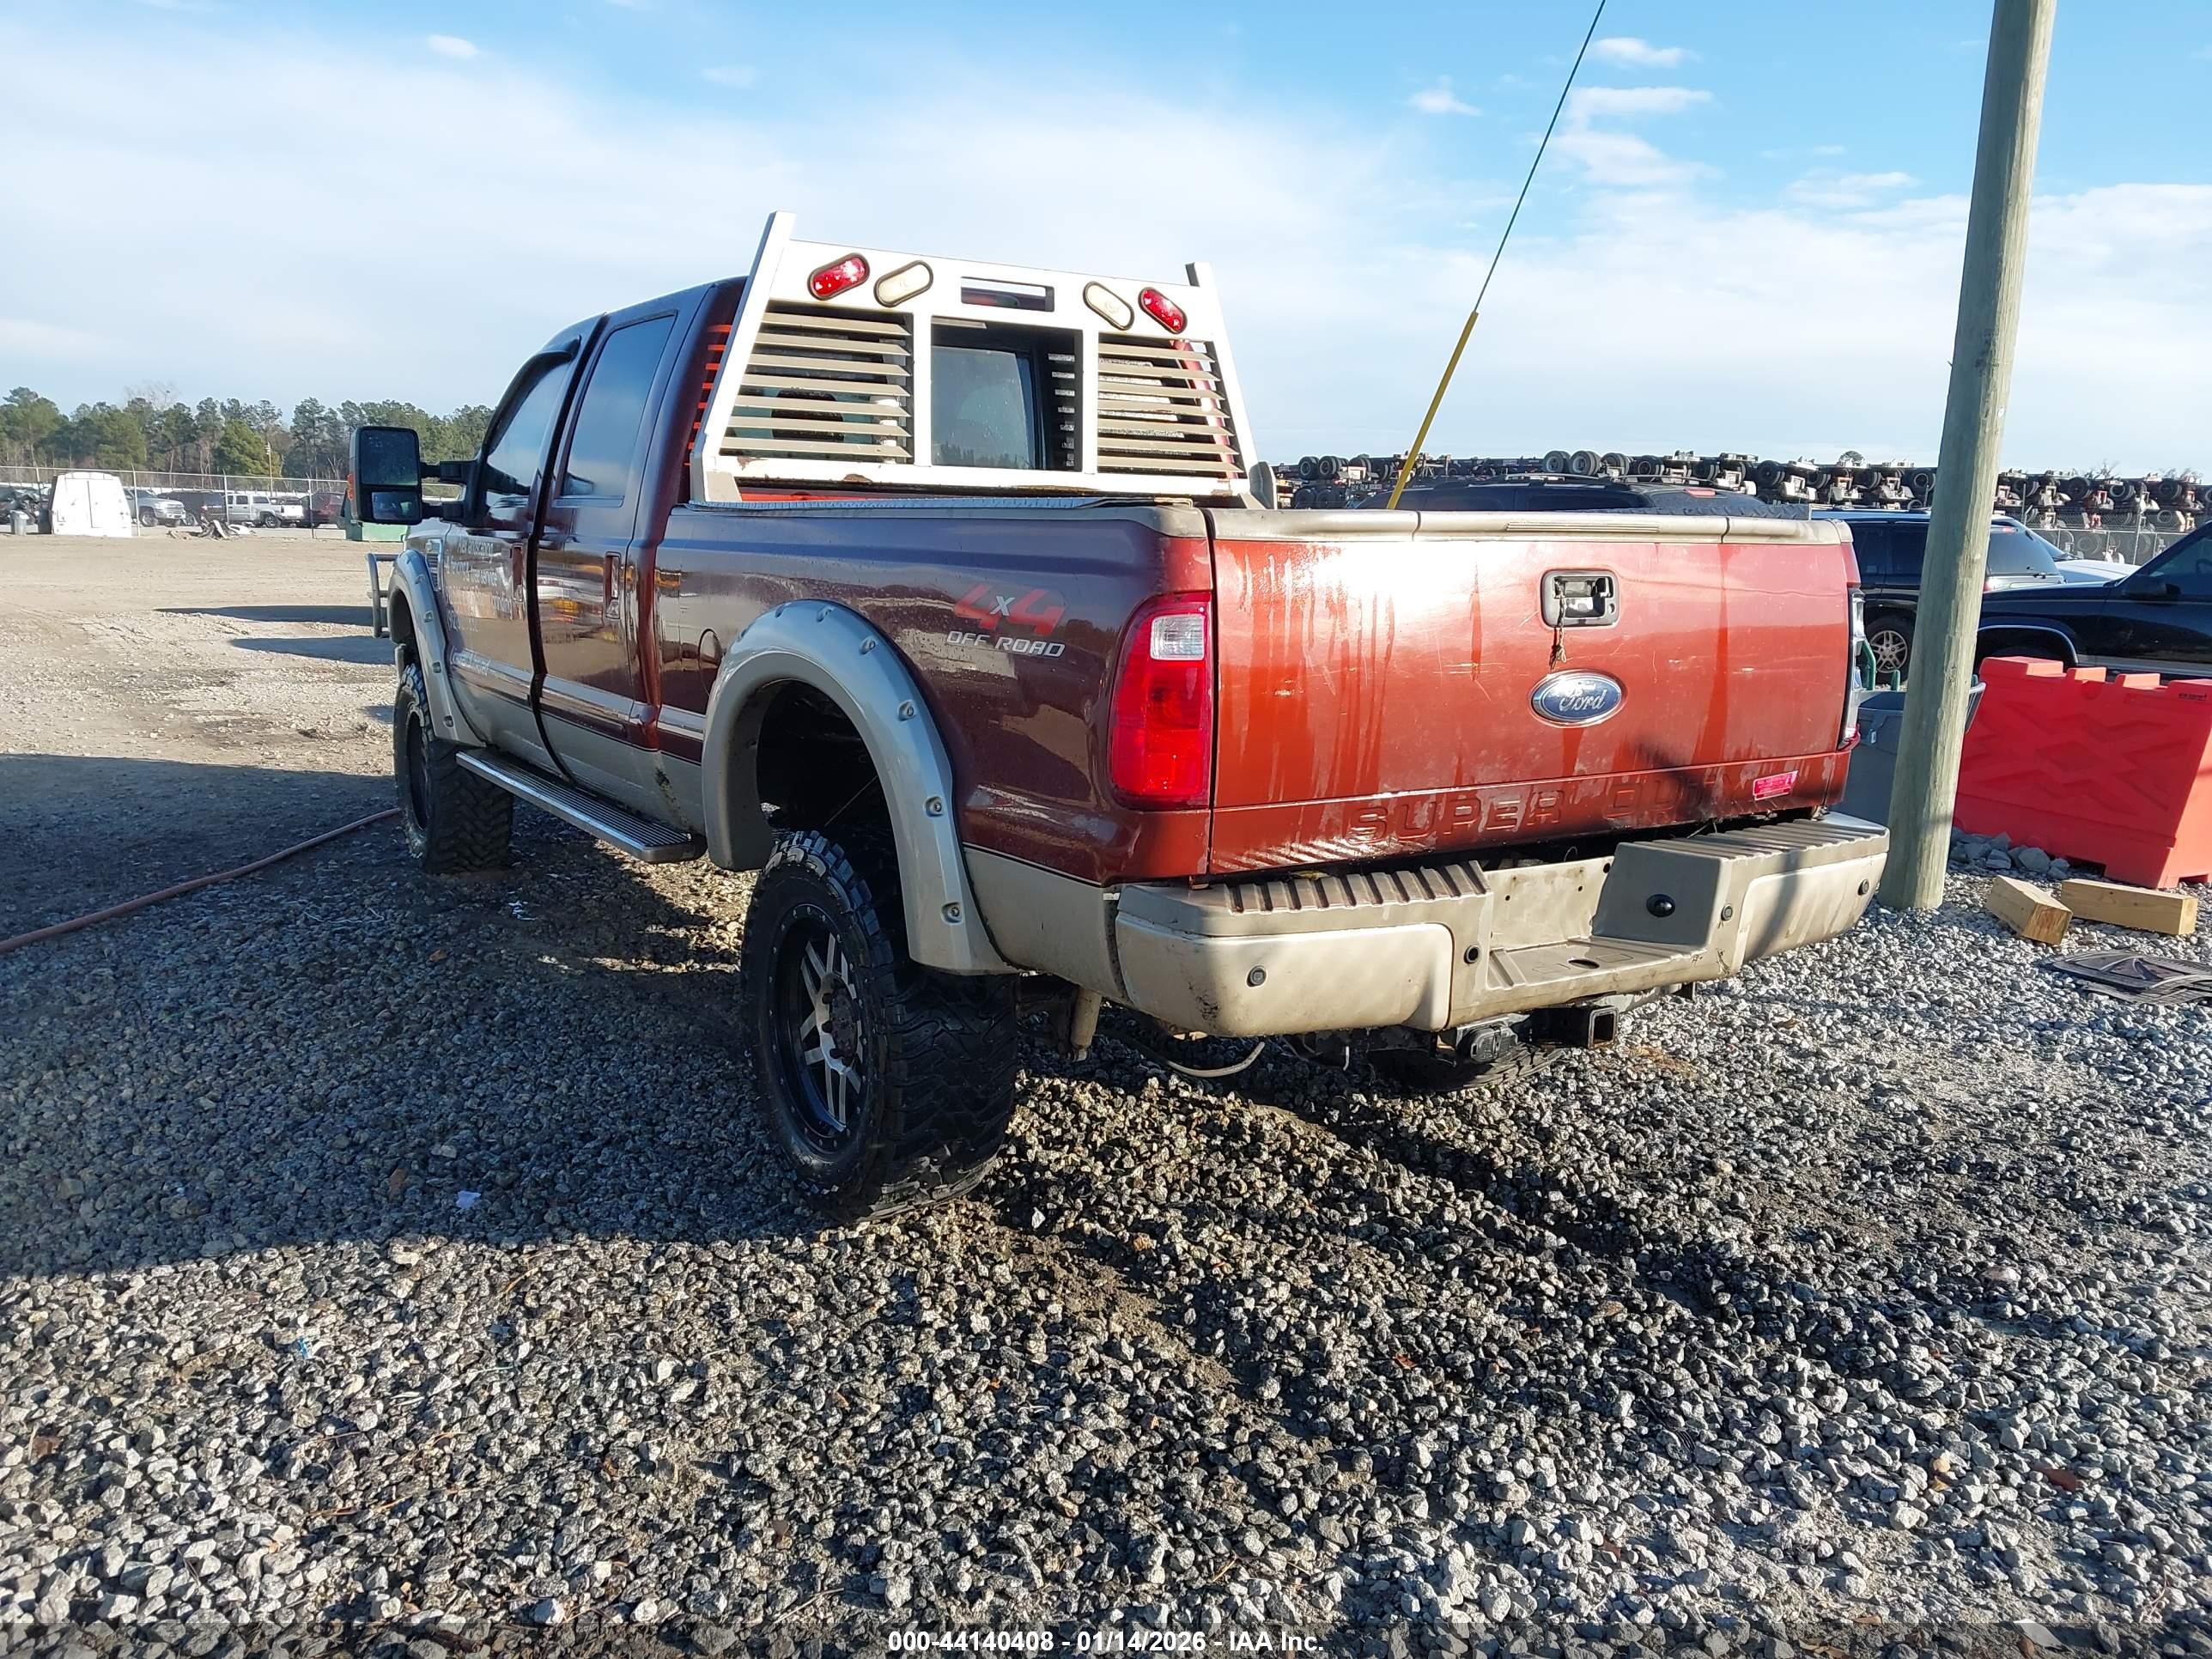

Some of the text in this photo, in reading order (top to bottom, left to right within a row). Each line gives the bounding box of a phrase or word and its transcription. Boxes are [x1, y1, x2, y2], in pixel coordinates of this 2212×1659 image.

[946, 630, 1066, 658] OFF ROAD
[1559, 689, 1608, 712] Ford
[1345, 788, 1565, 845] SUPER
